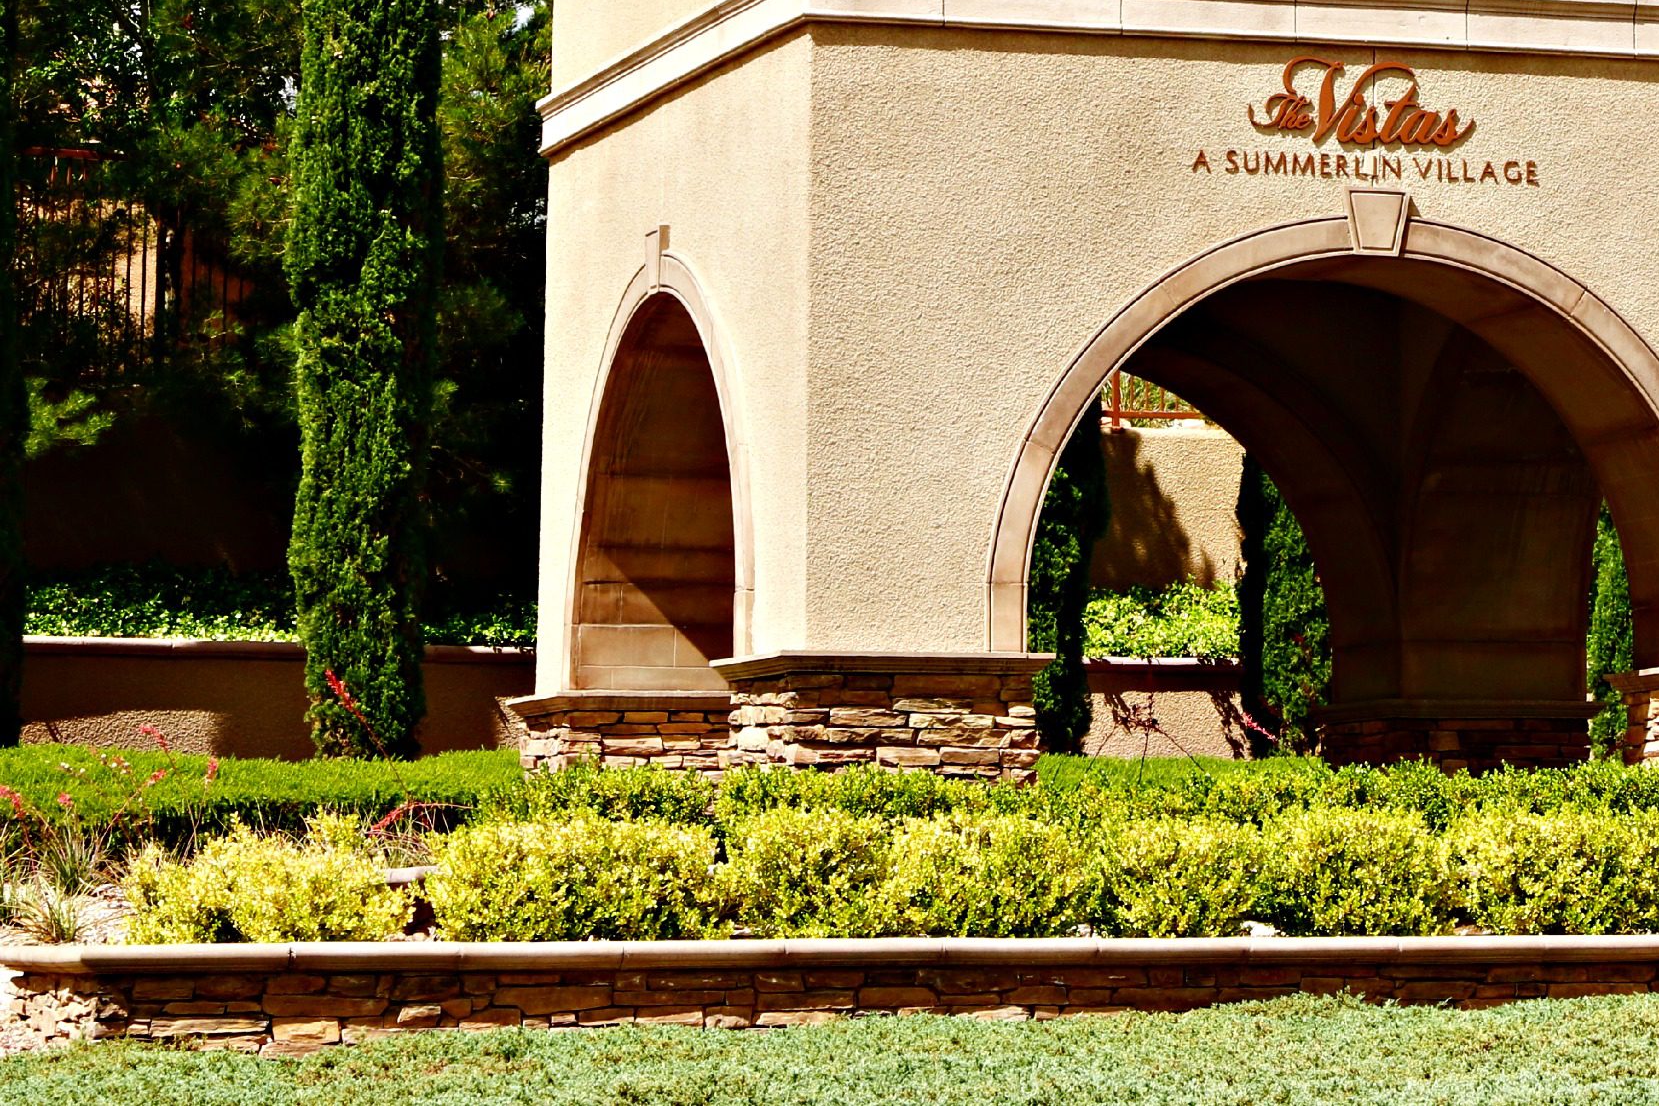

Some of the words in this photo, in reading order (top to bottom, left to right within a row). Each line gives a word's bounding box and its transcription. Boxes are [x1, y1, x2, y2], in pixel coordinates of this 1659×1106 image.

[1248, 93, 1313, 130] The
[1283, 55, 1477, 145] Vistas
[1192, 149, 1212, 174] A
[1225, 150, 1400, 180] SUMMERLIN
[1412, 156, 1540, 187] VILLAGE
